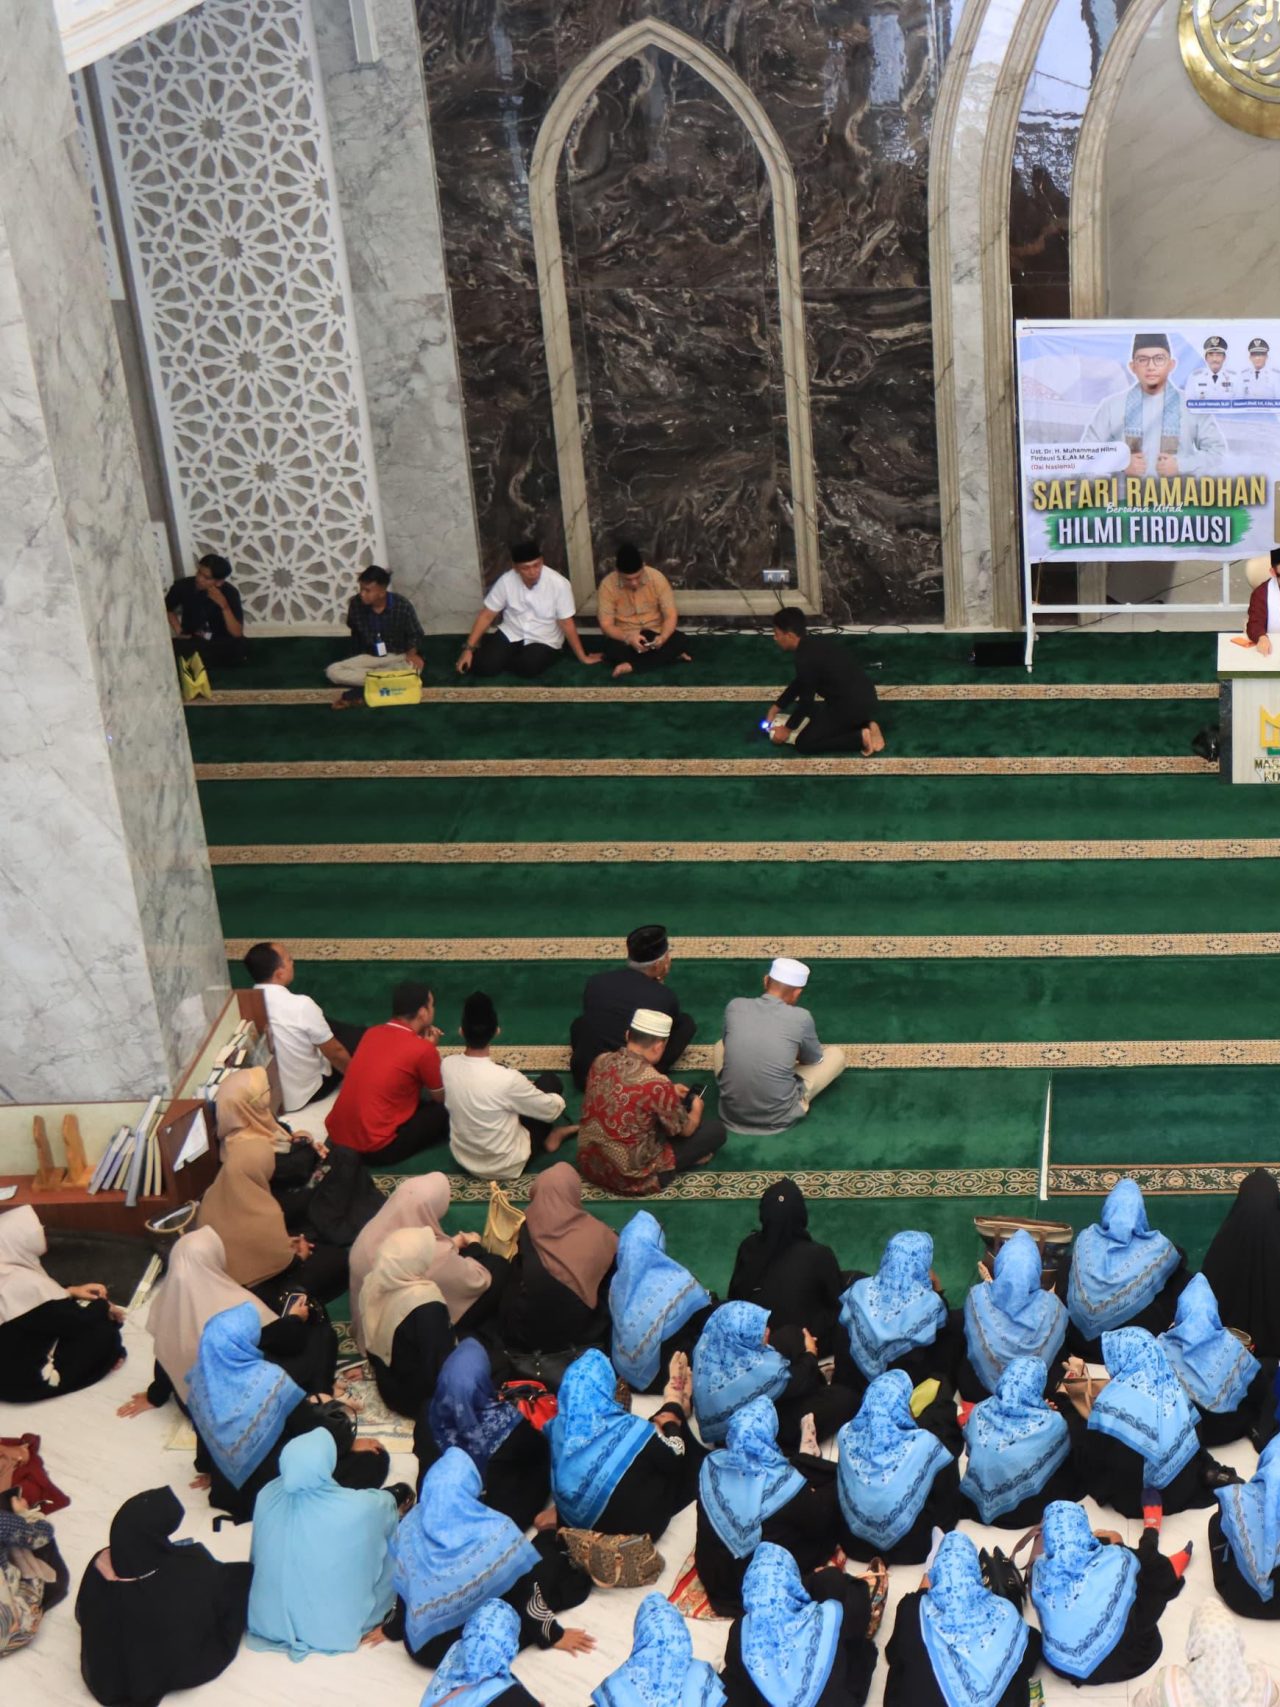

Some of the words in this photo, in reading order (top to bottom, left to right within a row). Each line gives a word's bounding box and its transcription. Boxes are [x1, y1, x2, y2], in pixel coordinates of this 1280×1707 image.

[1045, 463, 1076, 471] Nasional)
[1032, 477, 1118, 511] SAFARI
[1126, 475, 1267, 507] RAMADHAN
[1106, 502, 1151, 514] Bersama
[1058, 516, 1122, 544] HILMI
[1129, 515, 1231, 543] FIRDAUSI
